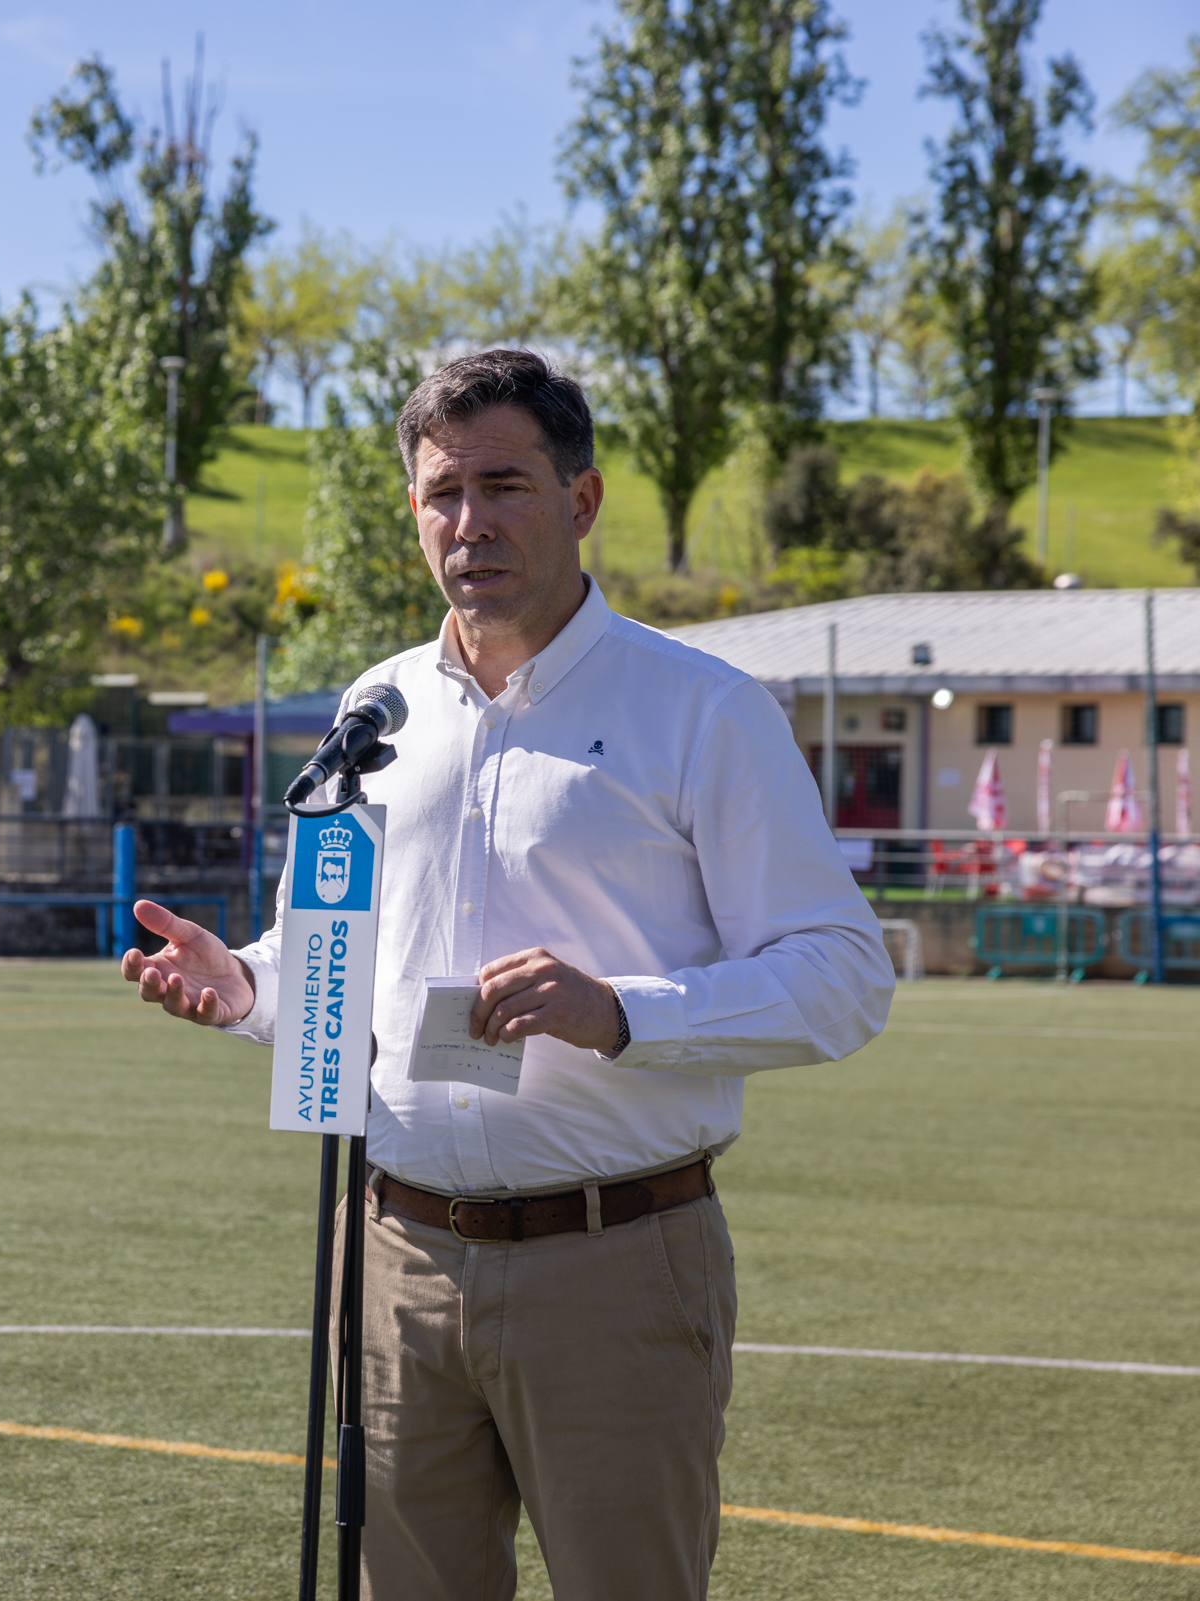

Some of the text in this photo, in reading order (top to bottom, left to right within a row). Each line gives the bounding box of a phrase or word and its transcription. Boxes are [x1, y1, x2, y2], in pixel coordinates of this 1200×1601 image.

[298, 933, 323, 1122] AYUNTAMIENTO
[320, 920, 348, 1122] TRES CANTOS
